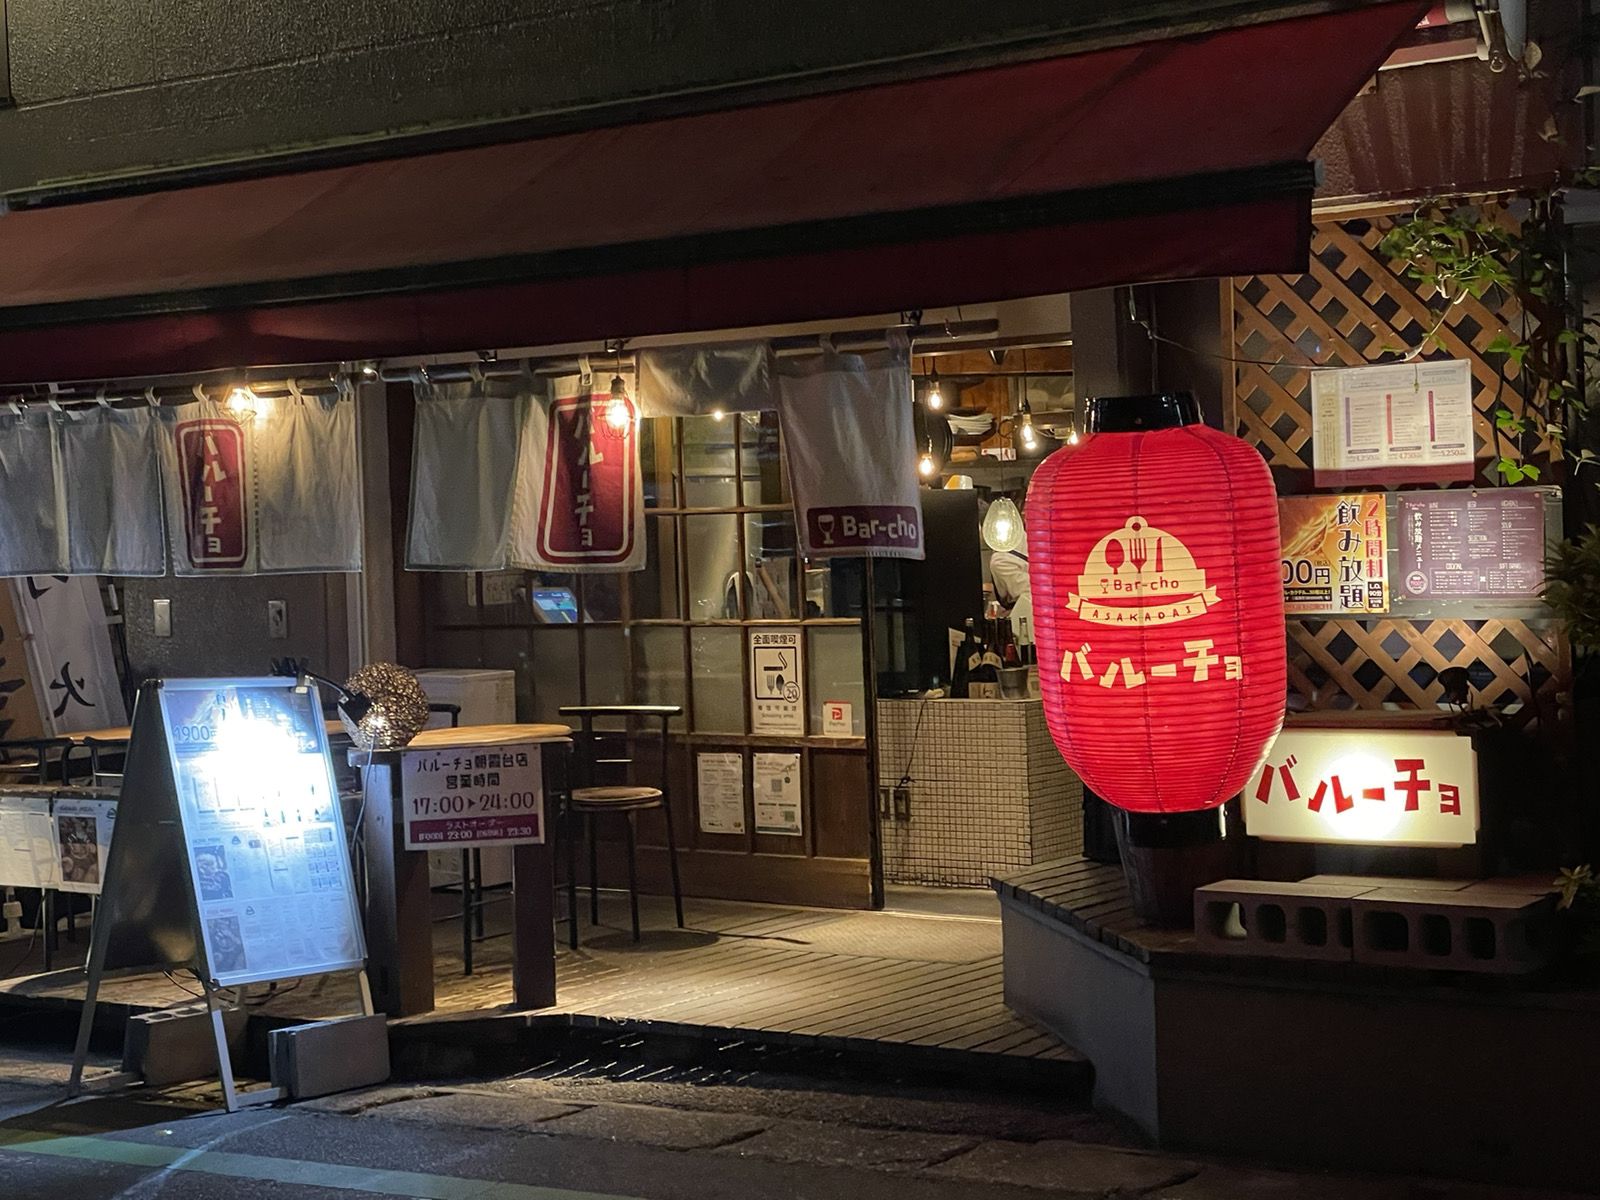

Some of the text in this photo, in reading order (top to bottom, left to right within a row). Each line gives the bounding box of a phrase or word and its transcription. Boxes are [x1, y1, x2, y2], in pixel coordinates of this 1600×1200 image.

[841, 513, 917, 540] Bar-cho
[1337, 500, 1364, 609] 飲み放題
[1113, 576, 1180, 592] Bar-cho
[1092, 605, 1193, 622] ASAKADAI
[753, 634, 796, 645] 全面喫煙可
[1060, 639, 1243, 689] バルーチョ
[417, 753, 528, 773] バルーチョ朝霞台店
[446, 772, 500, 790] 営業時間
[1255, 754, 1461, 816] バルーチョ
[413, 791, 535, 815] 17:00 24:00
